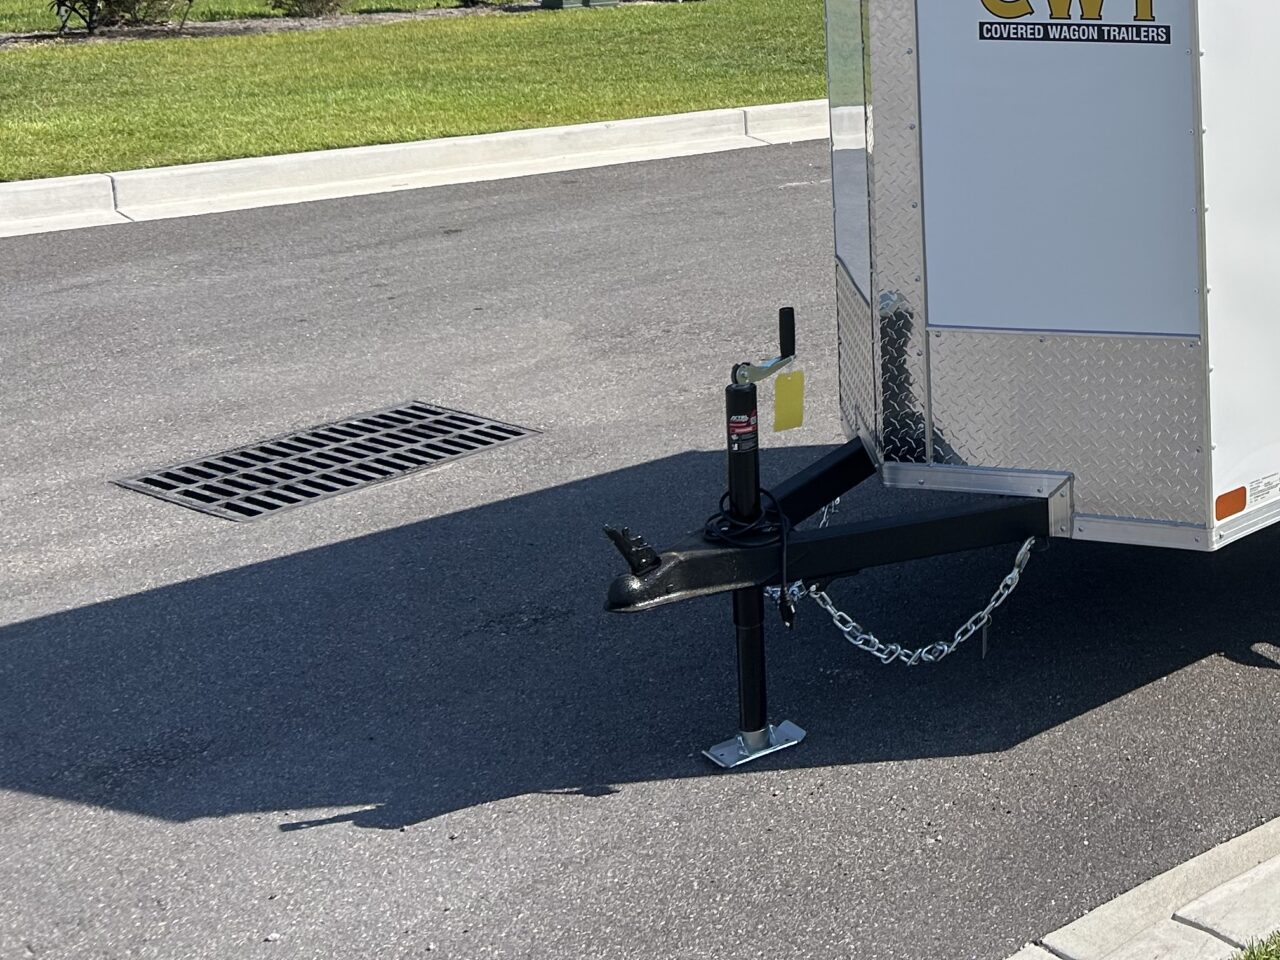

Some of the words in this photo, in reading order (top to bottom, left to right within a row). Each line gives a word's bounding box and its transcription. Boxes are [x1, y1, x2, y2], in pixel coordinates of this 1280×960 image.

[982, 23, 1044, 39] COVERED
[1047, 25, 1098, 40] WAGON
[1101, 26, 1167, 42] TRAILERS
